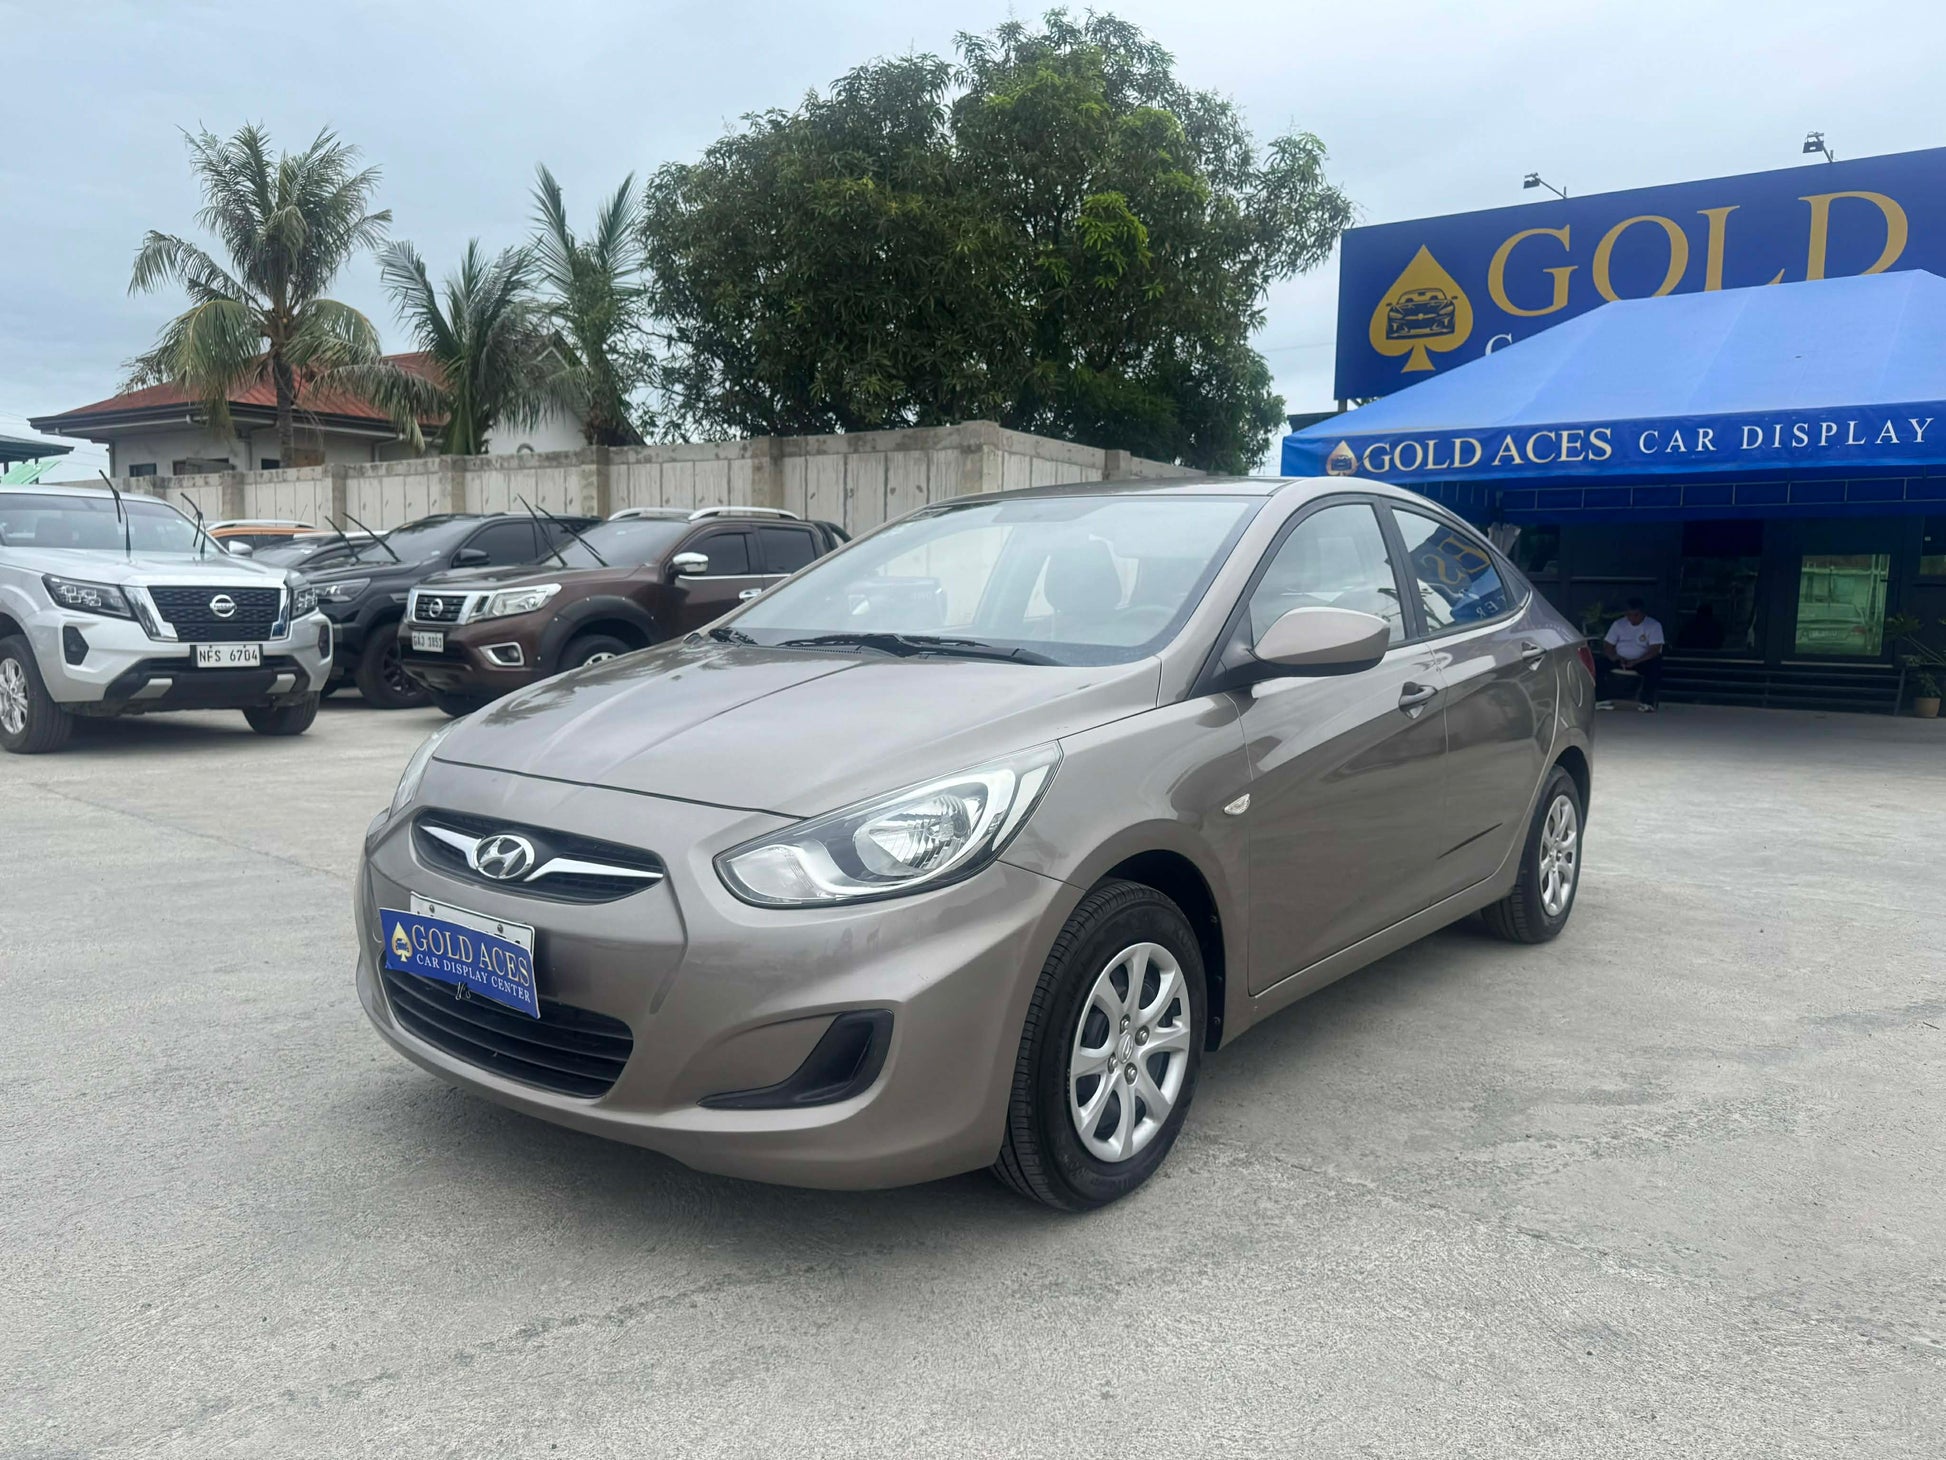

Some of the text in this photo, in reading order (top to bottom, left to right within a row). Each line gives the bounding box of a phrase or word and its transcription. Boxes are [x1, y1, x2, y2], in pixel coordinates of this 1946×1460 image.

[1487, 190, 1909, 317] GOLD
[1363, 418, 1935, 473] GOLD ACES CAR DISPLAY
[199, 649, 258, 663] NFS 6704
[411, 924, 473, 963] GOLD
[479, 942, 530, 987] ACES
[416, 953, 531, 1003] CAR DISPLAY CENTER
